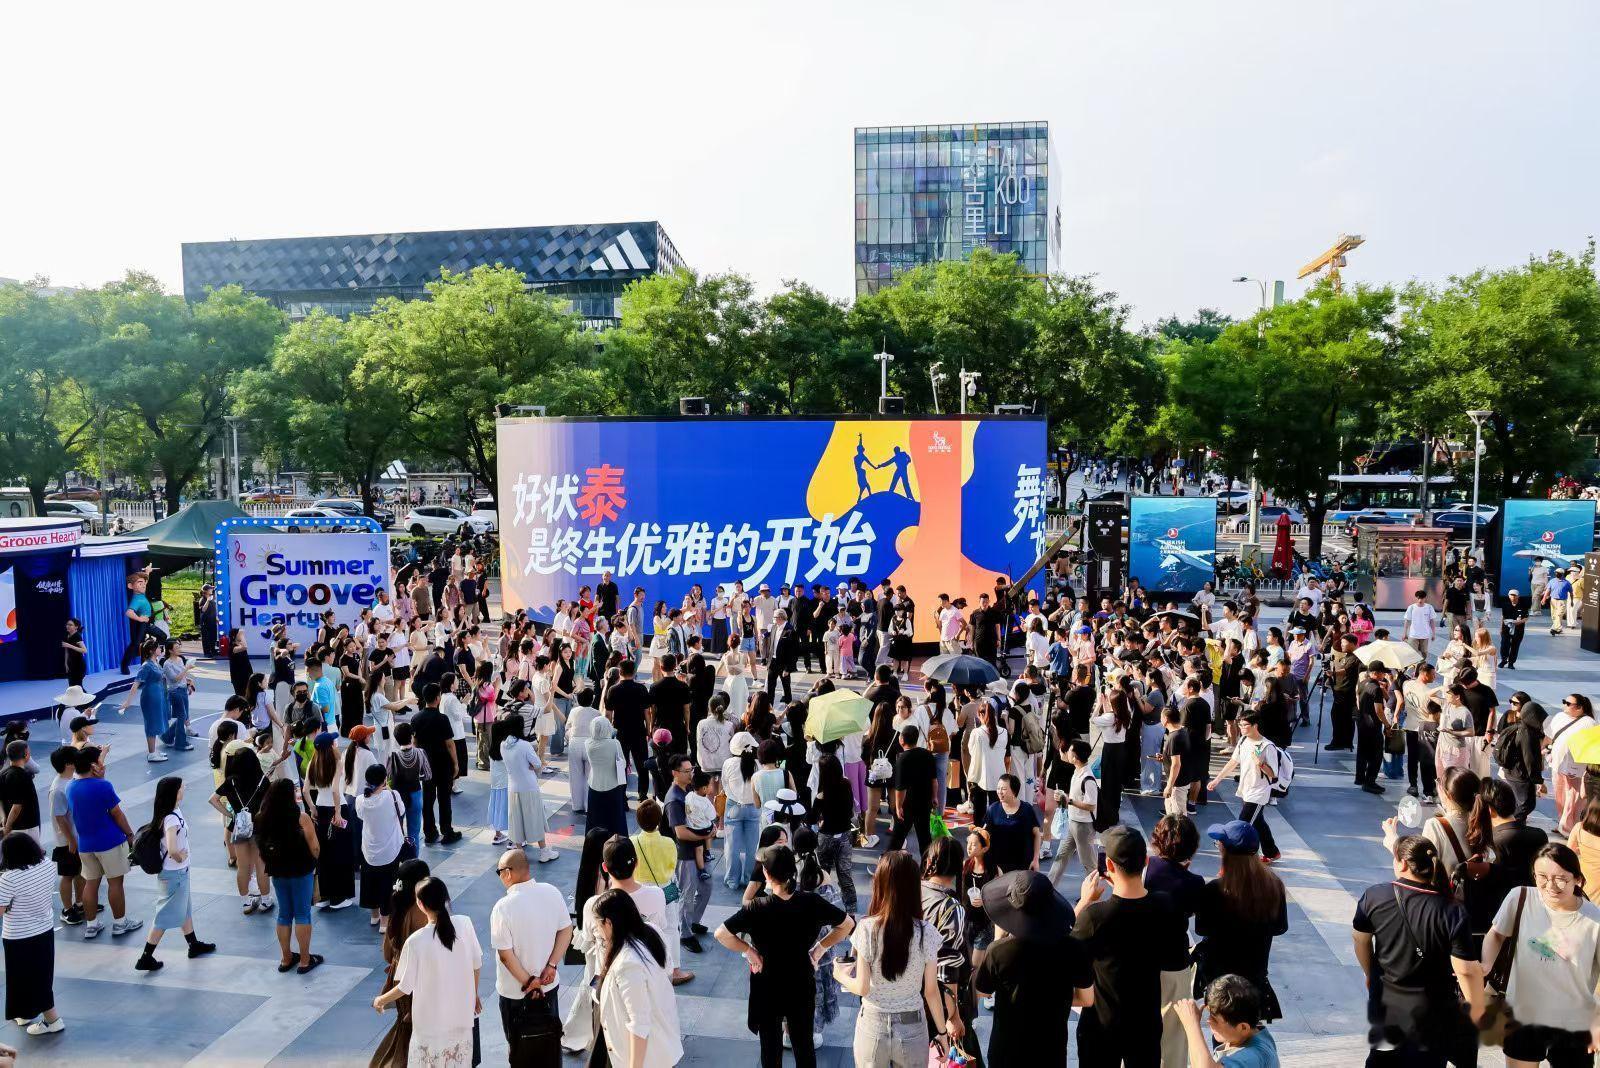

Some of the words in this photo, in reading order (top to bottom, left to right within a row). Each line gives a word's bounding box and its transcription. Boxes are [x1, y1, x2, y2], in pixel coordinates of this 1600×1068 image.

[994, 174, 1030, 205] KOO
[994, 206, 1008, 235] LI
[512, 463, 627, 528] 好状泰
[0, 535, 47, 548] Groove
[50, 532, 77, 545] Hearty
[523, 510, 878, 598] 是终生优雅的开始
[266, 553, 375, 576] Summer
[240, 574, 375, 606] Groove
[240, 607, 320, 629] Hearty
